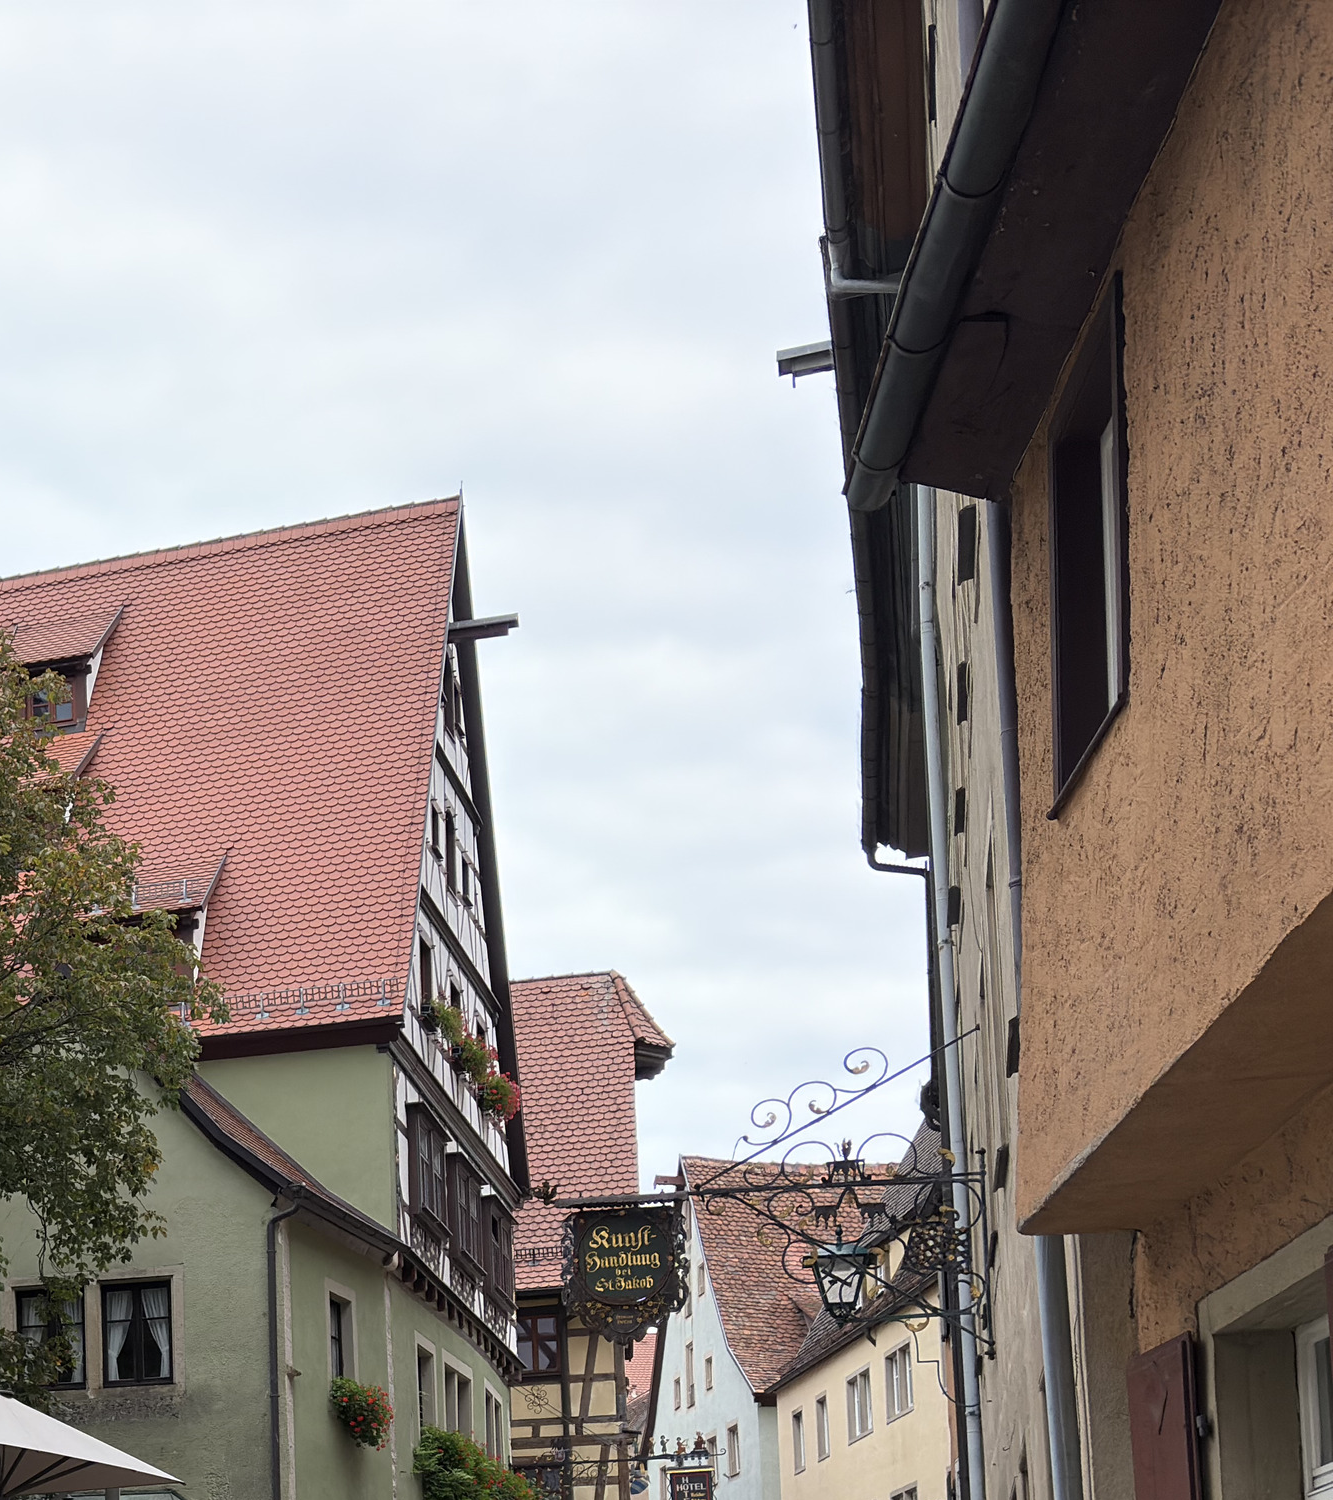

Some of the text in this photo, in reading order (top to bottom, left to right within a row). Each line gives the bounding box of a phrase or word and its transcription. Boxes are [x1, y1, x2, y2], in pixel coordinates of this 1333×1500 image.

[585, 1251, 661, 1272] Handlung
[615, 1267, 632, 1276] bei
[676, 1483, 706, 1492] HOTEL
